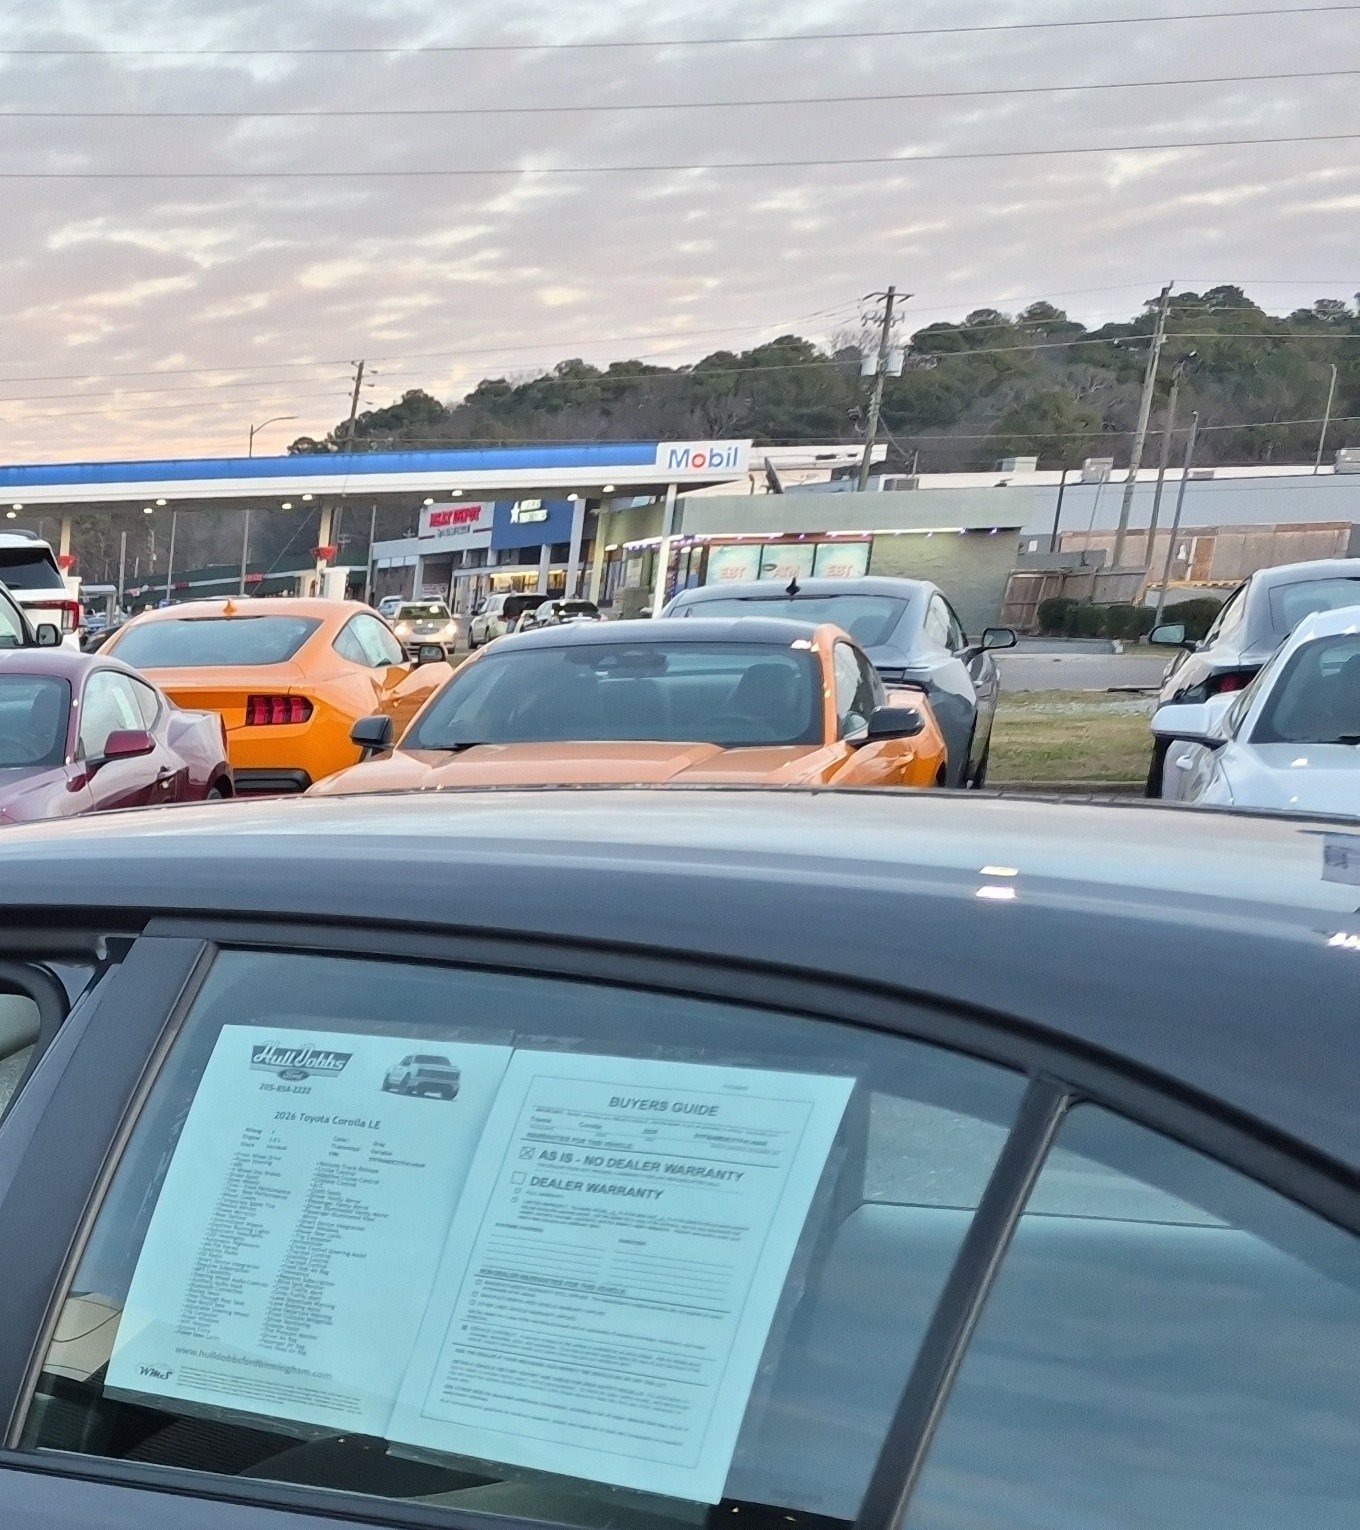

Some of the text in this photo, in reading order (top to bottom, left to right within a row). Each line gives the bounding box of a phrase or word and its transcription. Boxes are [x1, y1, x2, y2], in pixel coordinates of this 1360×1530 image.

[668, 446, 739, 469] Mobil
[253, 1040, 345, 1070] Hull Dobbs
[609, 1096, 667, 1112] BUYERS
[672, 1101, 721, 1117] GUIDE
[274, 1111, 381, 1130] 2026 Toyota Corolla LE
[538, 1149, 557, 1162] AS
[560, 1152, 573, 1163] IS
[583, 1155, 603, 1167] NO
[606, 1157, 662, 1173] DEALER
[664, 1163, 744, 1182] WARRANTY
[531, 1175, 664, 1200] DEALER WARRANTY
